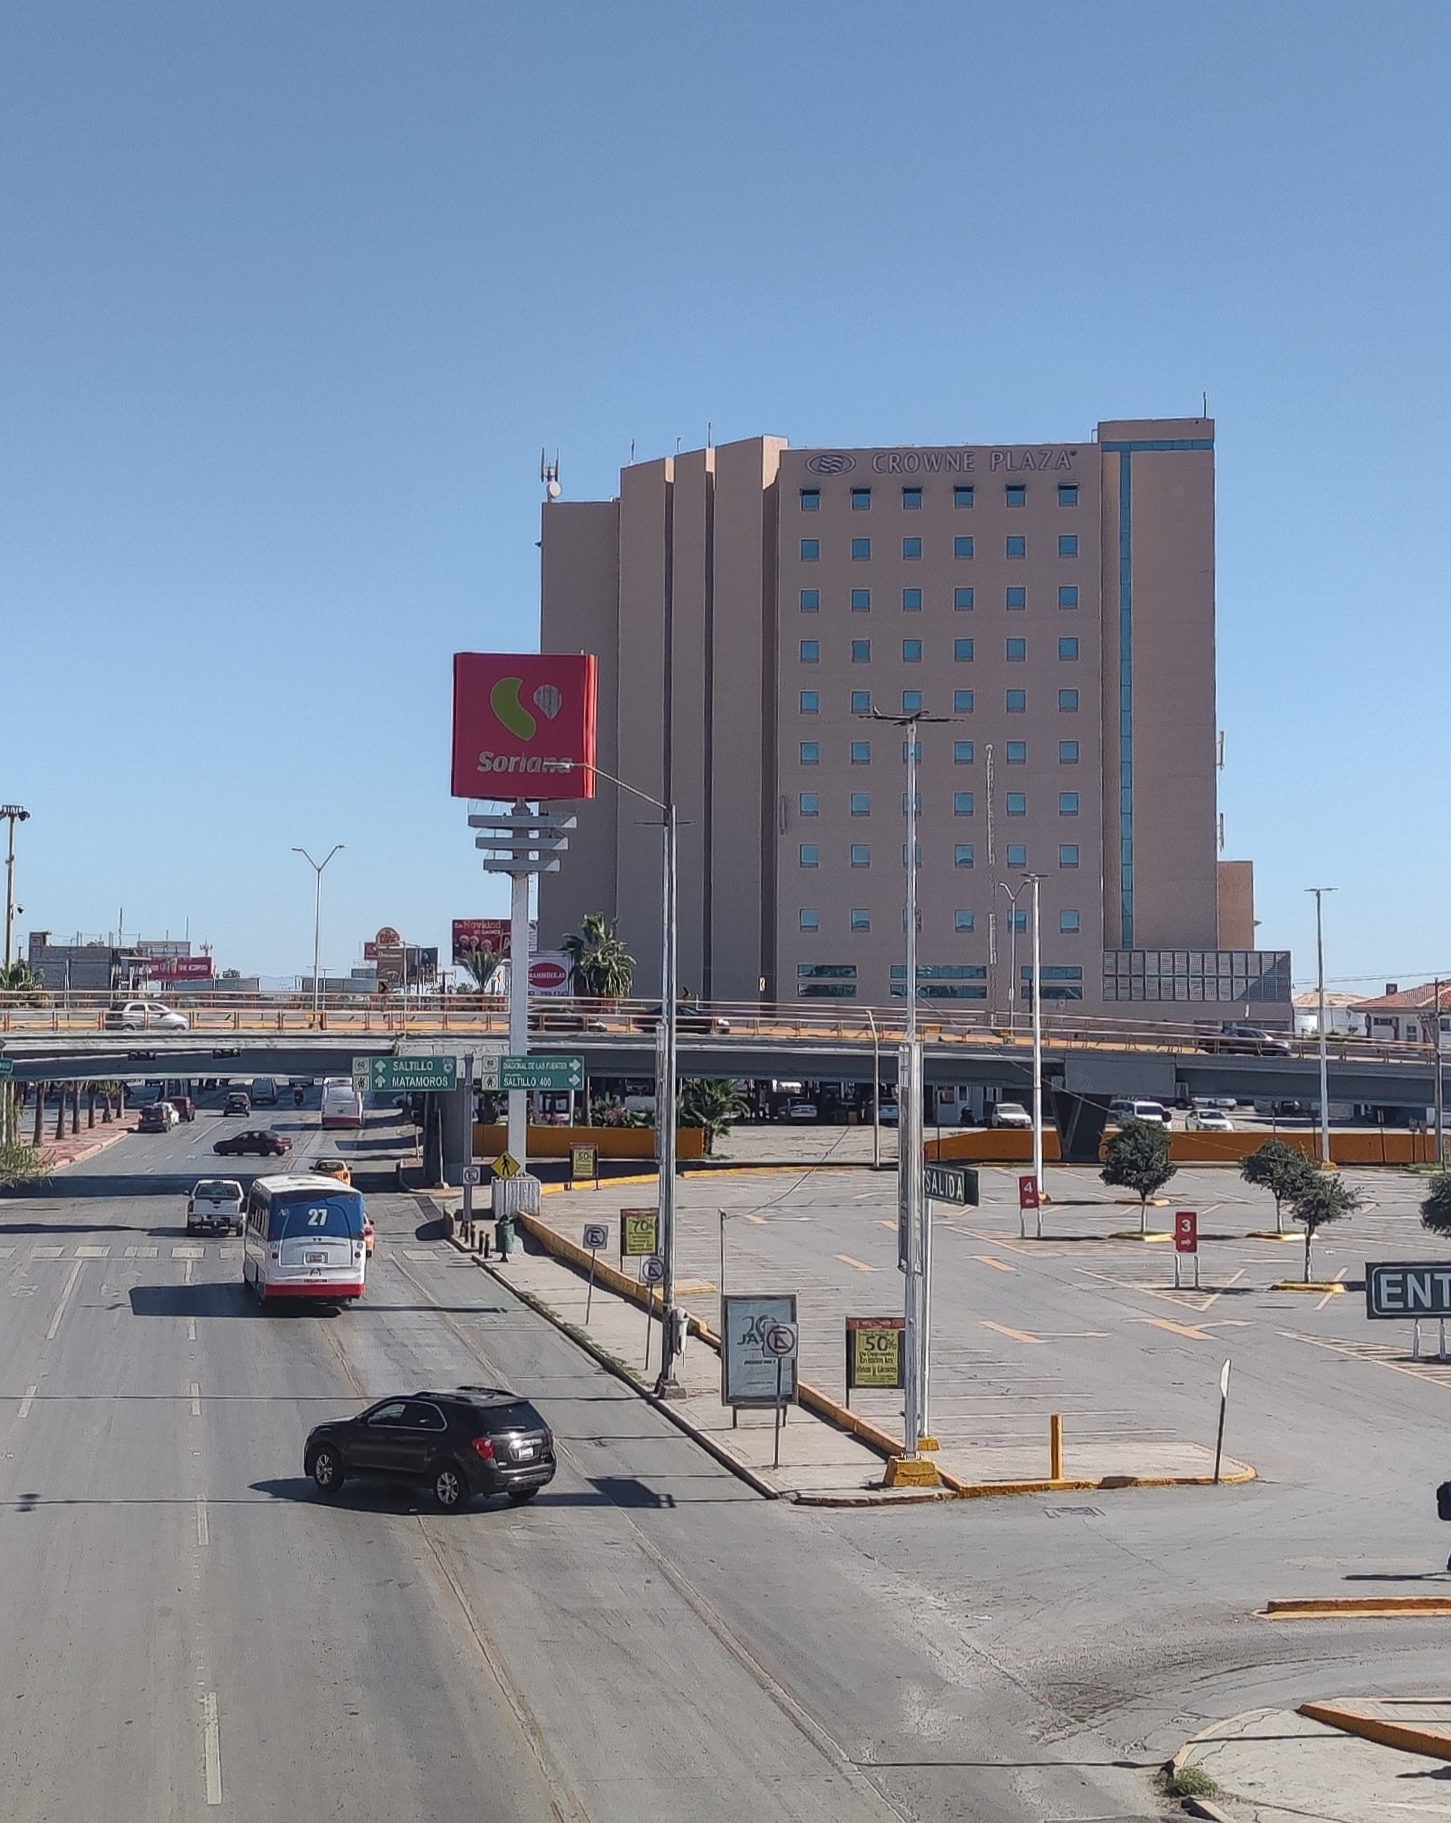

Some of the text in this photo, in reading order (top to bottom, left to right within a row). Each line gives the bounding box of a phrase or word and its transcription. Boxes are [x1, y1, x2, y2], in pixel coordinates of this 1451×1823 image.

[871, 450, 1073, 474] CROWNE PLAZA
[477, 750, 574, 774] Soriana
[463, 921, 502, 930] Navidad
[392, 1060, 434, 1071] SALTILLO
[503, 1061, 528, 1070] DIAGONAL
[528, 1061, 535, 1070] DE
[535, 1061, 545, 1070] LAS
[392, 1076, 449, 1087] MATAMOROS
[503, 1077, 552, 1087] SALTILLO 400
[925, 1169, 964, 1200] SALIDA
[1023, 1181, 1033, 1194] 4
[308, 1209, 327, 1226] 27
[1180, 1219, 1192, 1233] 3
[1380, 1273, 1451, 1308] ENT
